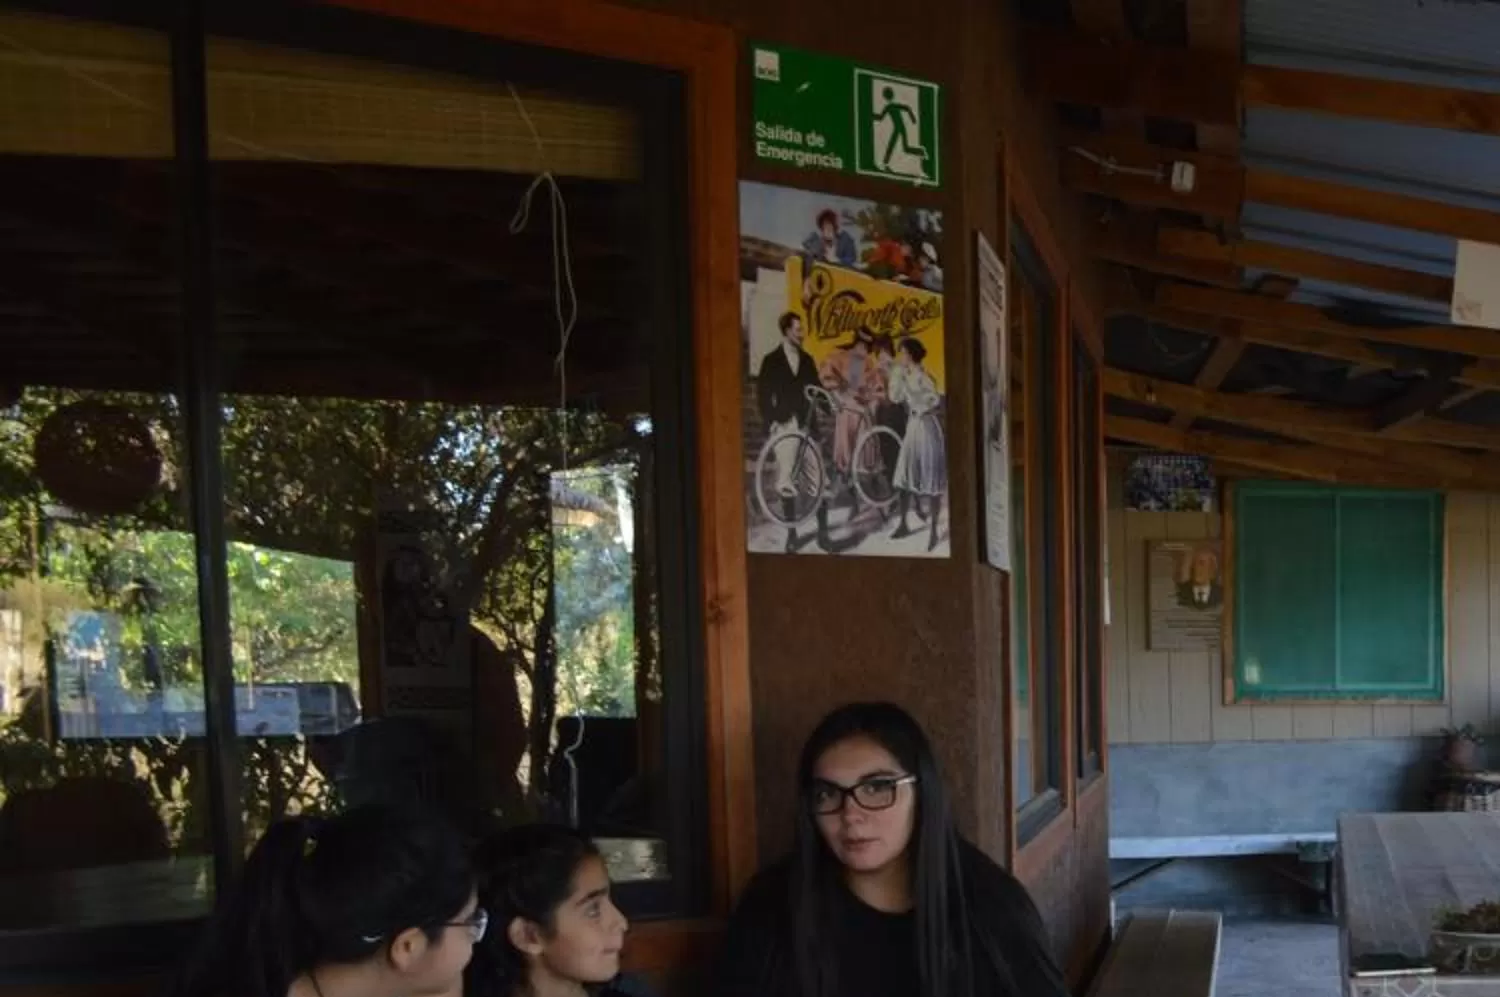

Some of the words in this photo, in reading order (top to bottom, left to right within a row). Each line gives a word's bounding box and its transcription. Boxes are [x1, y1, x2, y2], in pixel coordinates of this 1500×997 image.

[755, 120, 803, 146] Salida
[805, 129, 826, 149] de
[755, 140, 844, 170] Emergencia
